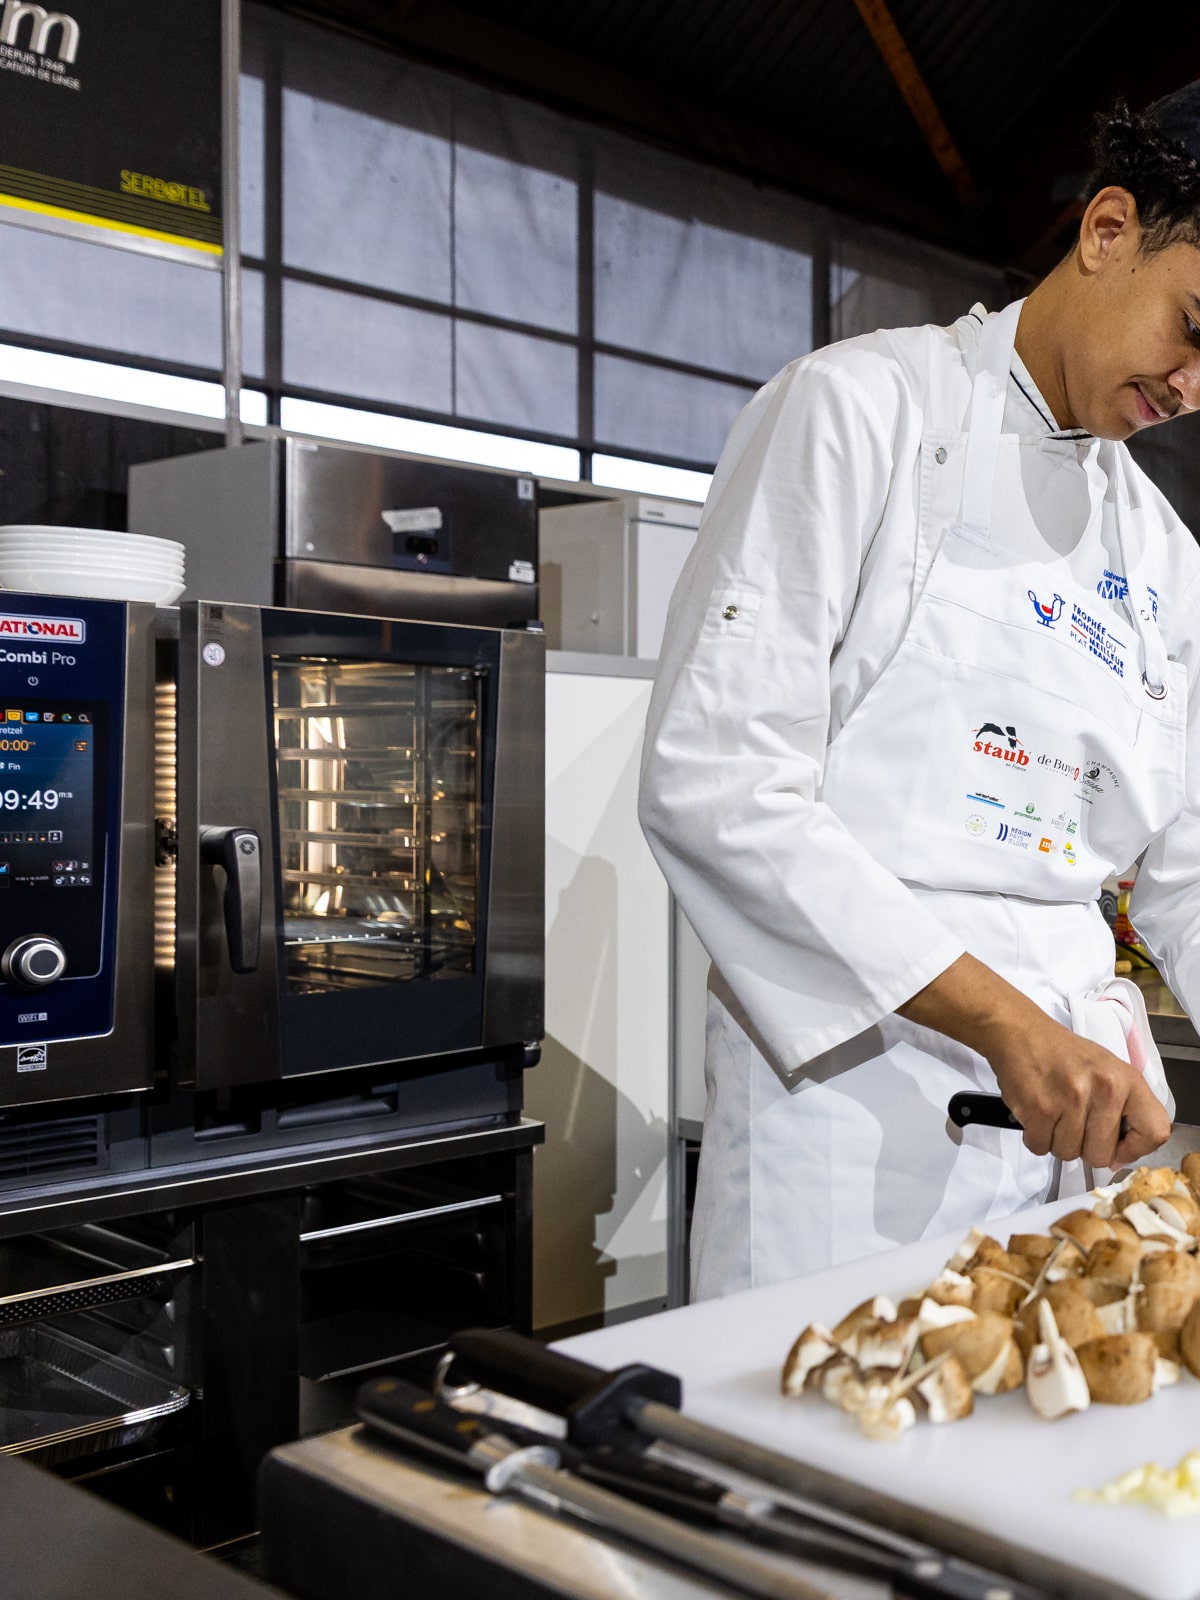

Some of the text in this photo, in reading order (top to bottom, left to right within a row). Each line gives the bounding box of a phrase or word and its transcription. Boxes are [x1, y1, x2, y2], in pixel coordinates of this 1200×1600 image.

[119, 169, 211, 213] SERBOTEL
[1072, 603, 1107, 636] TROPHÉE
[1071, 613, 1117, 653] MONDIAL DU
[1070, 630, 1124, 669] PLAT MEILLEUR
[52, 651, 76, 666] Pro
[1089, 645, 1124, 678] FRANÇAIS
[0, 739, 29, 751] 0:00
[973, 740, 1029, 766] staub
[1037, 754, 1052, 766] de
[8, 762, 21, 770] Fin
[1086, 760, 1120, 789] CHAMPAGNE
[1013, 810, 1042, 822] promocash
[1009, 832, 1024, 842] PAYS
[1010, 826, 1032, 838] RÉGION
[1012, 840, 1029, 850] LOIRE
